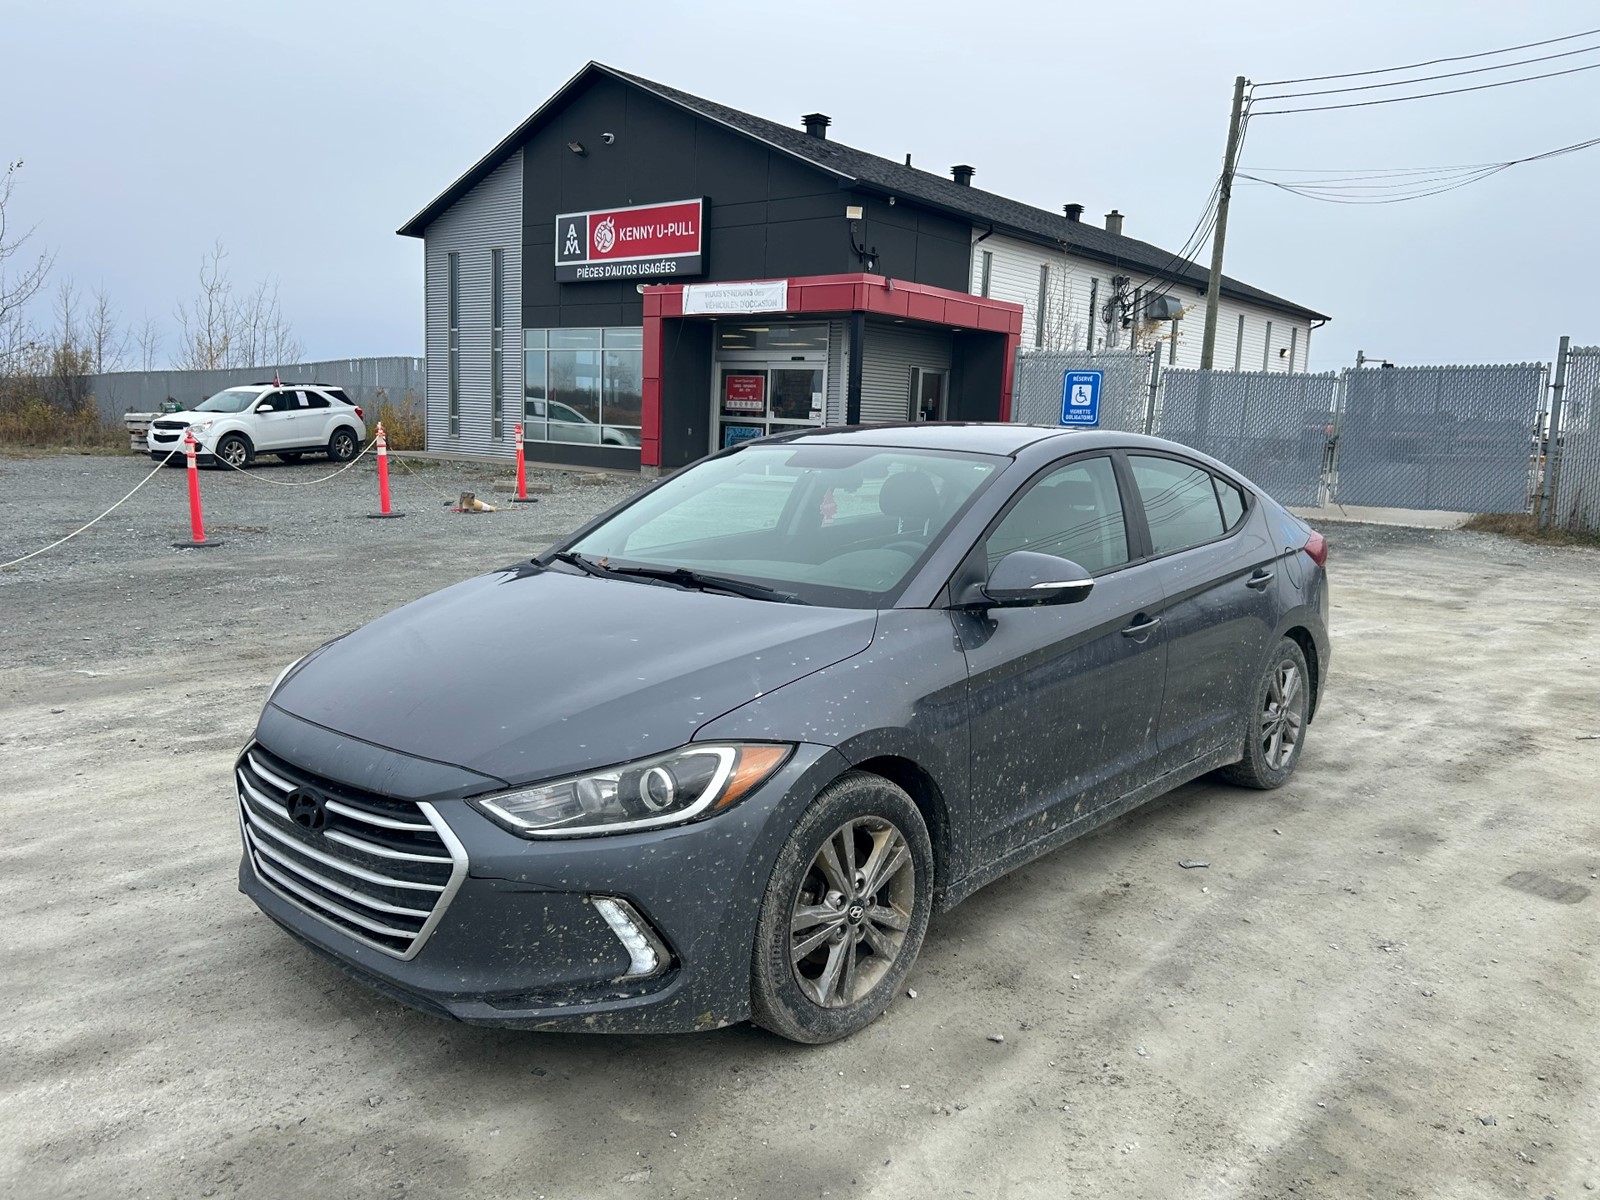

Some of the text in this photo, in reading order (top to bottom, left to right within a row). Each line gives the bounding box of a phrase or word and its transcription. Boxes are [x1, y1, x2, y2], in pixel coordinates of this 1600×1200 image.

[619, 221, 695, 241] KENNY U-PULL
[577, 260, 676, 278] PIÈCES D'AUTOS USAGÉES
